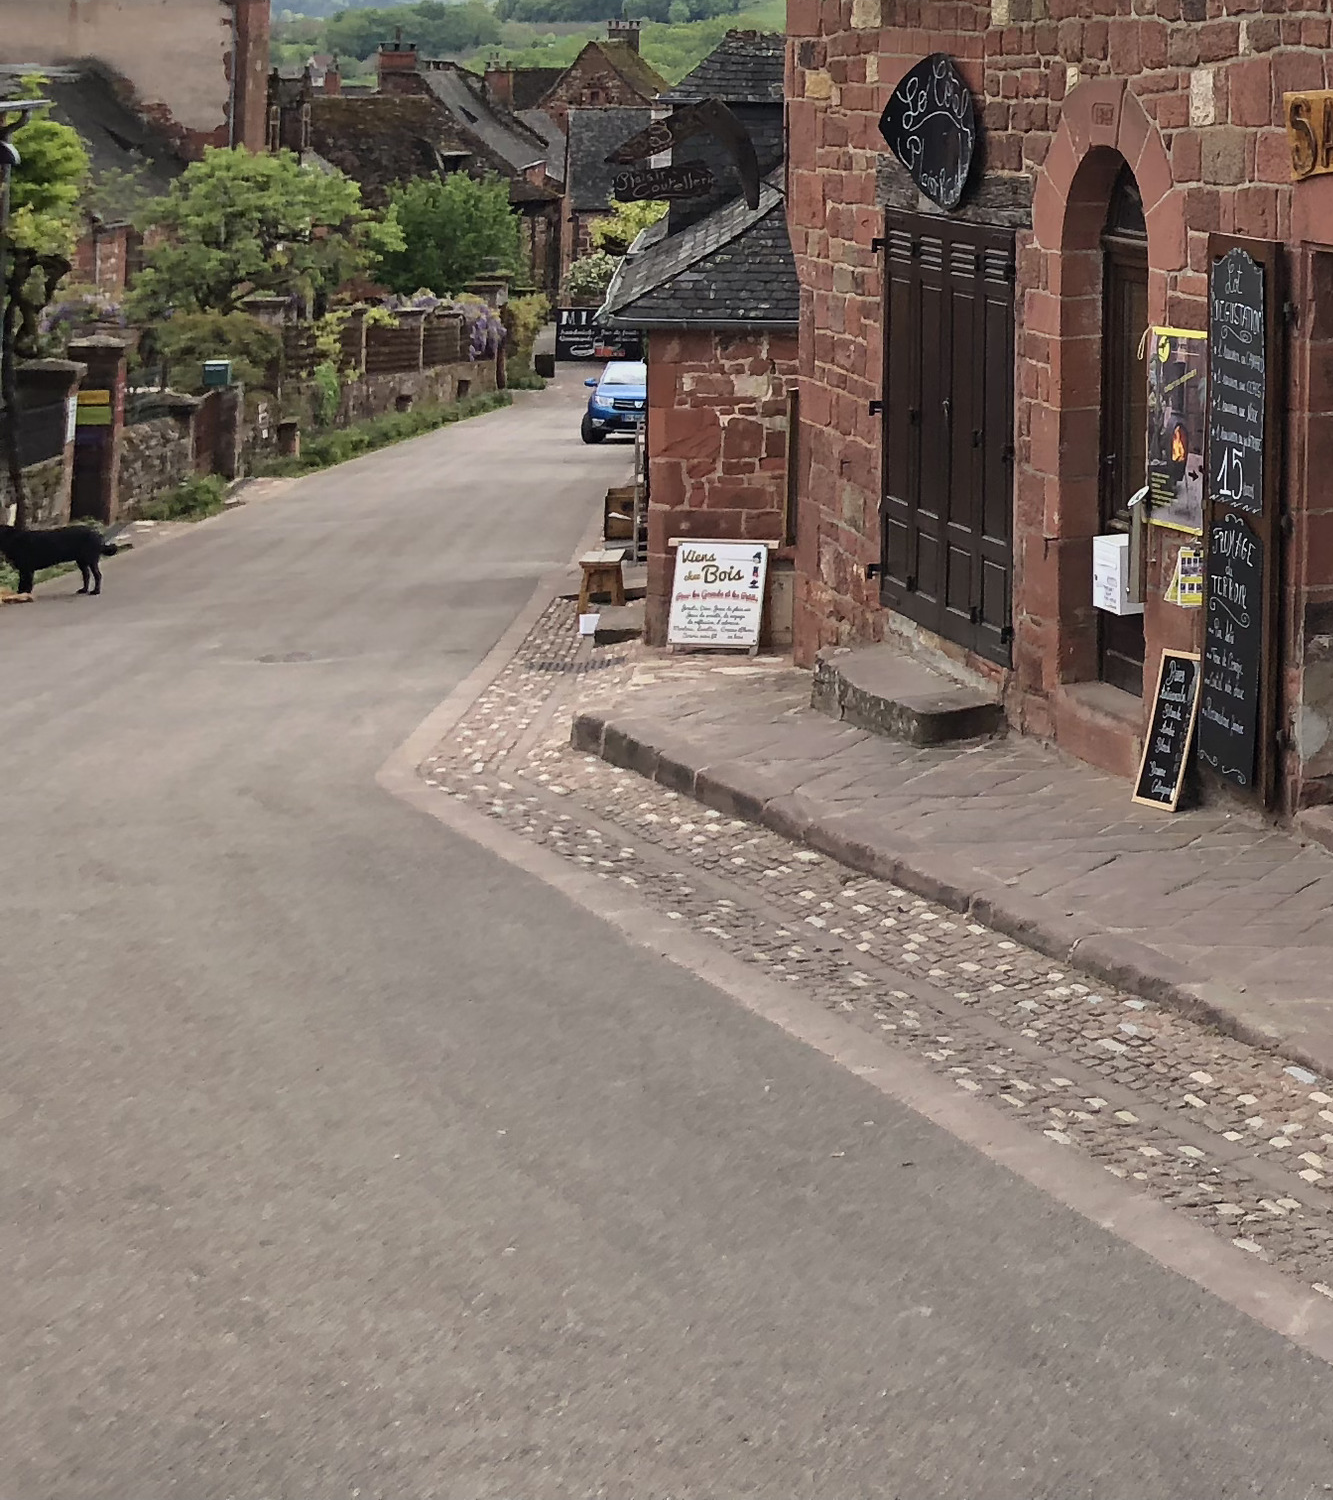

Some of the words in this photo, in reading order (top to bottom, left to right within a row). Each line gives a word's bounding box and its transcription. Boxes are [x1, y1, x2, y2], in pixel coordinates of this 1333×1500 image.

[560, 311, 599, 325] MI
[1217, 446, 1243, 500] 15
[701, 564, 744, 583] Bois
